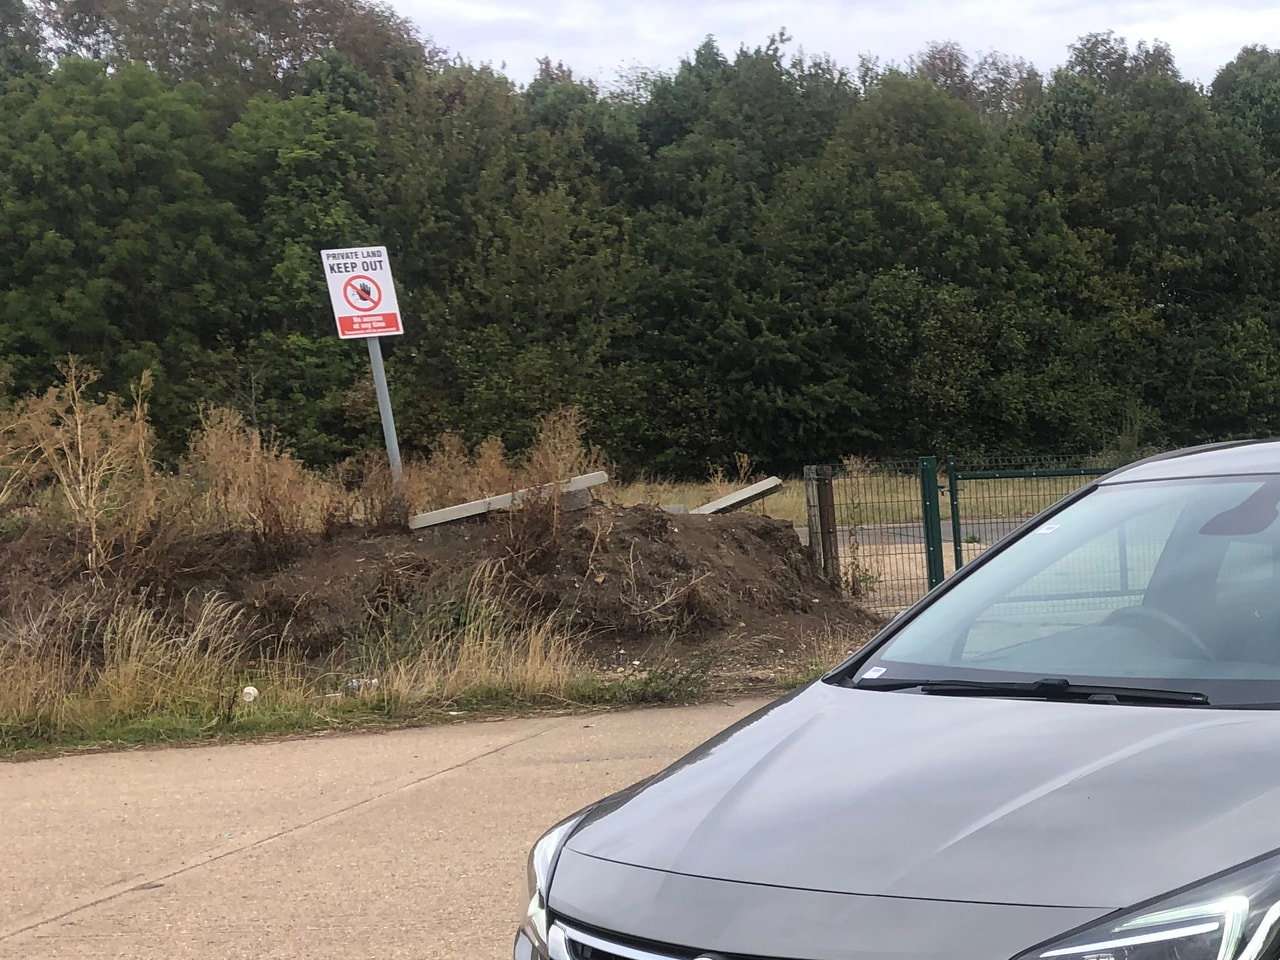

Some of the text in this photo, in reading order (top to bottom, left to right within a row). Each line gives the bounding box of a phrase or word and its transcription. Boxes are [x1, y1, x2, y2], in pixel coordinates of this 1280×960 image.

[326, 250, 382, 260] PRIVATE LAND
[329, 260, 383, 273] KEEP OUT
